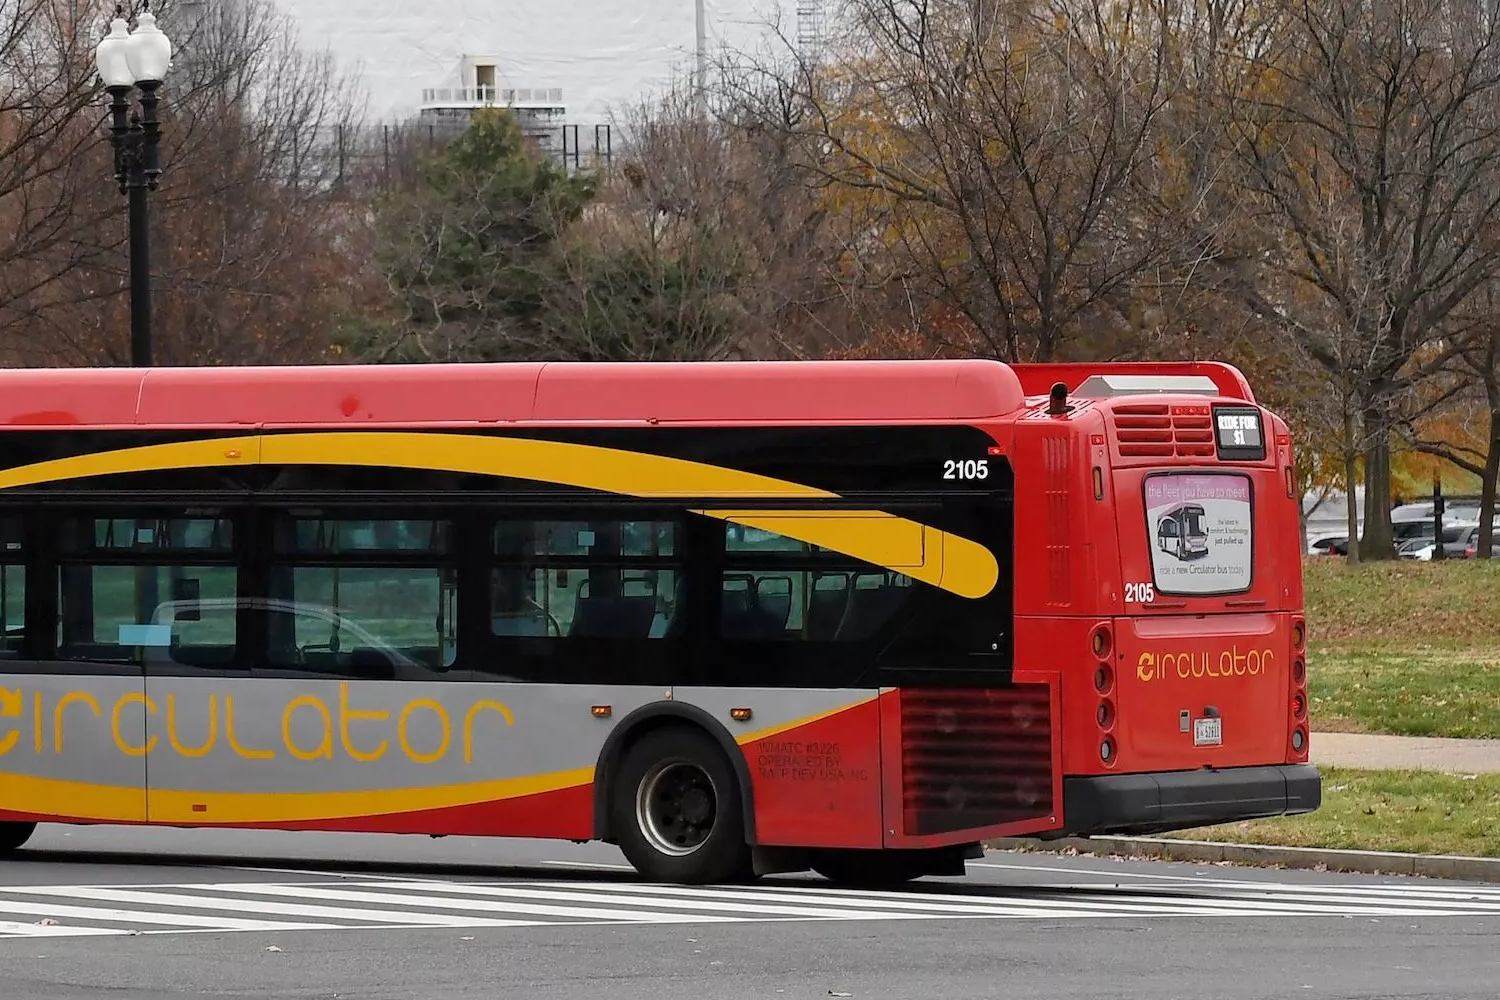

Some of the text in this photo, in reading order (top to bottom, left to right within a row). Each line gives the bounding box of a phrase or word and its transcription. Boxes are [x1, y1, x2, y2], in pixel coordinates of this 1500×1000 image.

[1217, 415, 1257, 430] RIDE FOR
[1233, 429, 1246, 445] $1
[943, 459, 989, 480] 2105
[1148, 484, 1161, 498] the
[1124, 583, 1155, 602] 2105
[758, 755, 821, 767] OPERAED
